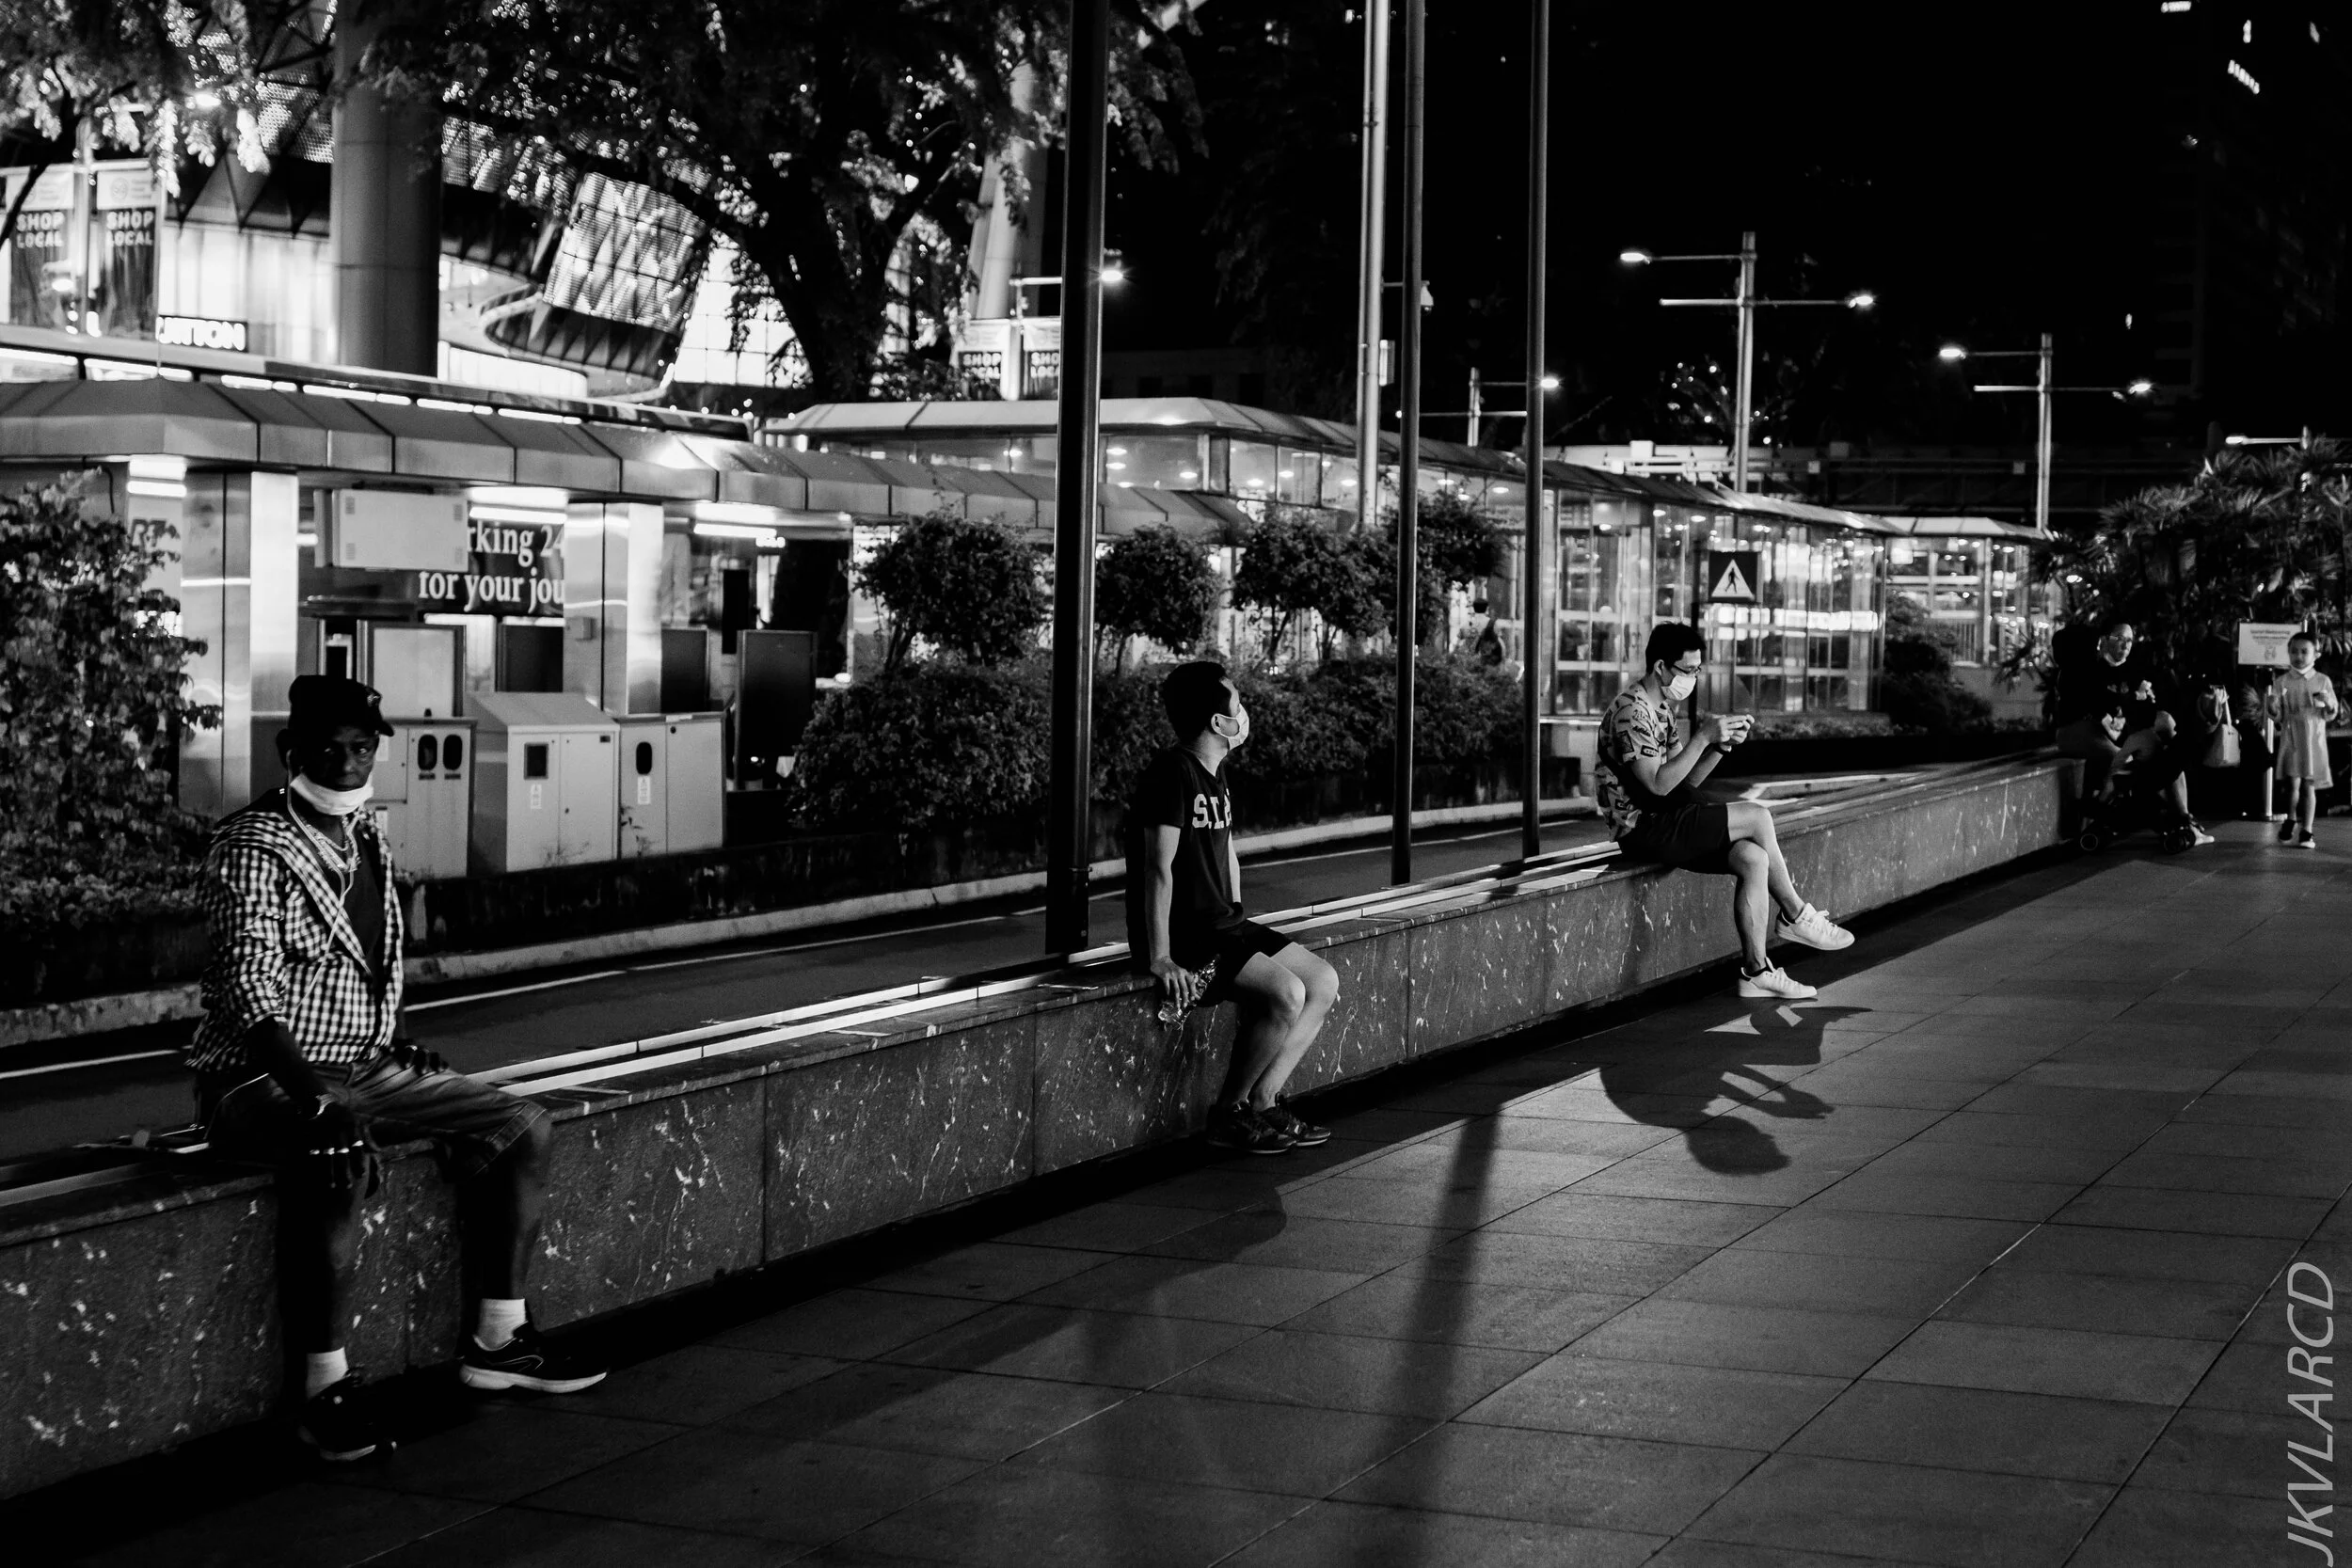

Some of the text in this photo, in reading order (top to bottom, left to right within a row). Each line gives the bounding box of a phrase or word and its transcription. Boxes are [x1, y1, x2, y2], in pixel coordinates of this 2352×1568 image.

[16, 211, 65, 231] SHOP
[106, 210, 154, 230] SHOP
[16, 231, 63, 248] LOCAL
[419, 570, 460, 600] for
[464, 574, 524, 612] your
